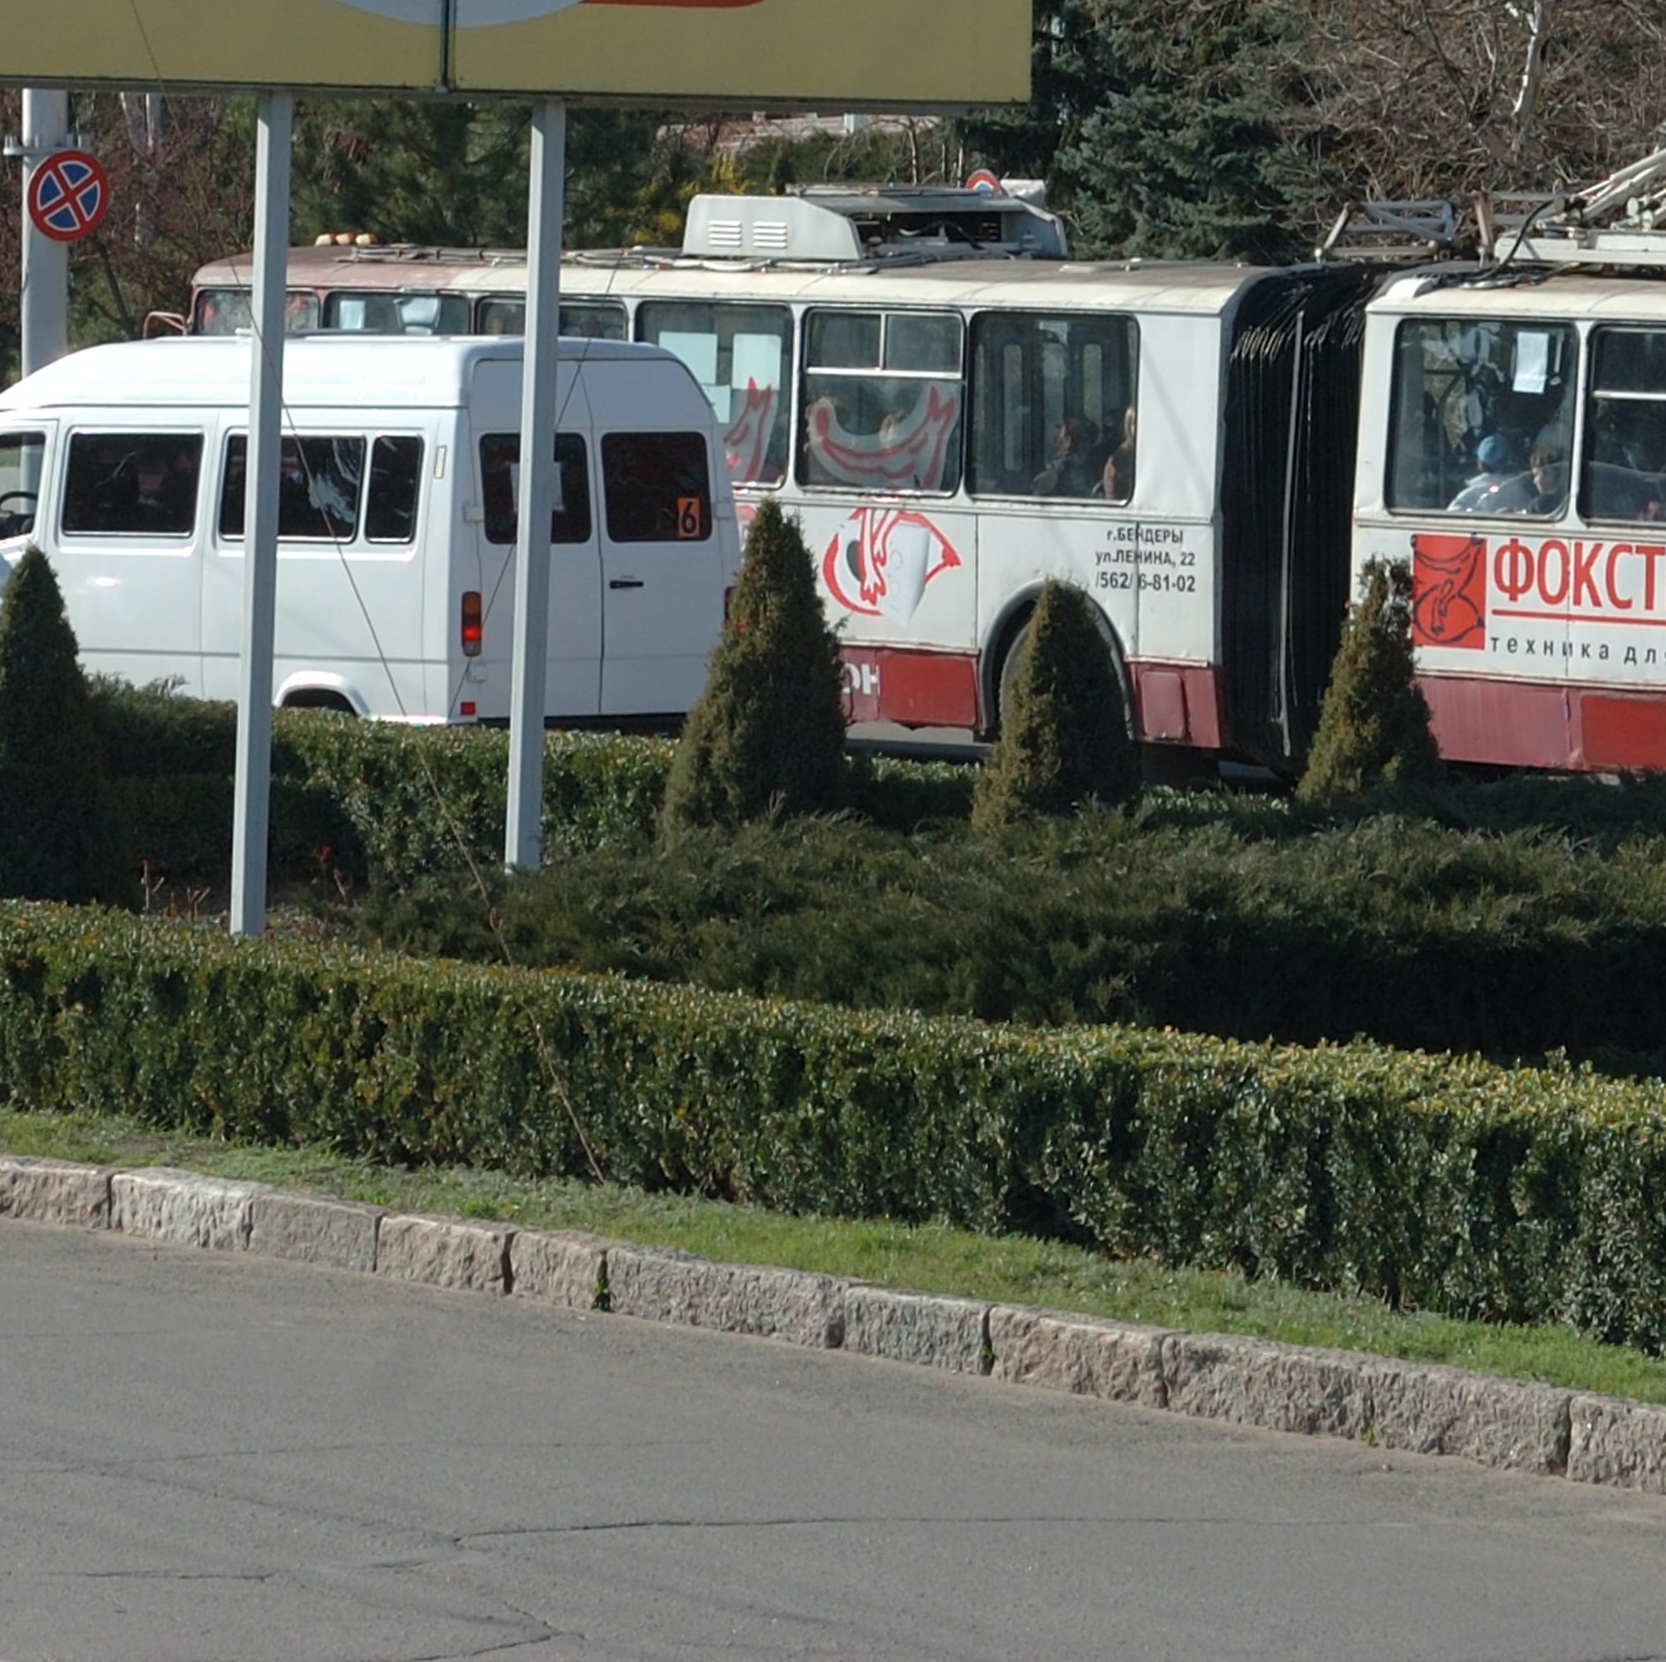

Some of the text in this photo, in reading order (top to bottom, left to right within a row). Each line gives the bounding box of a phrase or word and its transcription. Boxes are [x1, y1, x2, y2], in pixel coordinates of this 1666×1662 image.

[681, 500, 698, 535] 6
[1180, 551, 1196, 567] 22
[1137, 573, 1196, 593] 6-81-02
[1490, 637, 1610, 661] техника
